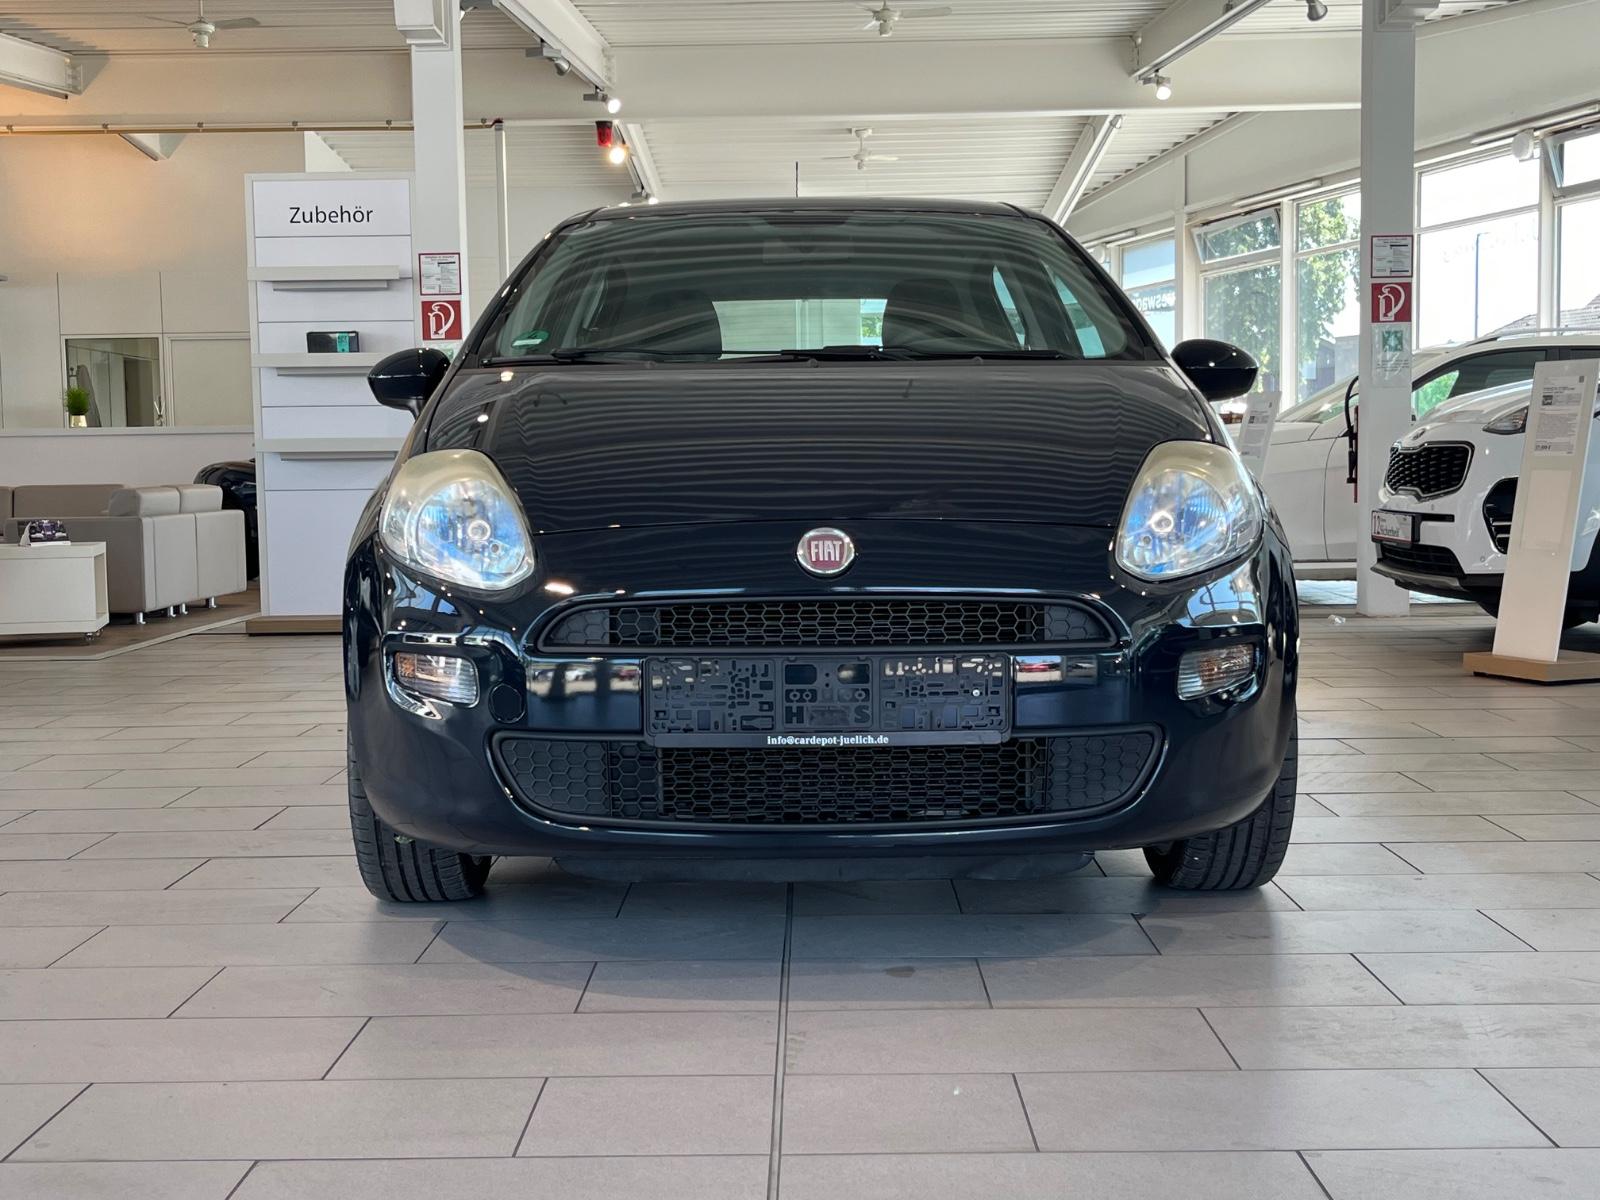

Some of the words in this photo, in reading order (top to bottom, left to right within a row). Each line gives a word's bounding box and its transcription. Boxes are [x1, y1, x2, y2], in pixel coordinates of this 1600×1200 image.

[289, 205, 374, 223] Zubehör
[810, 540, 843, 562] FIAT
[767, 735, 889, 746] info@cardepot-juelich.de
